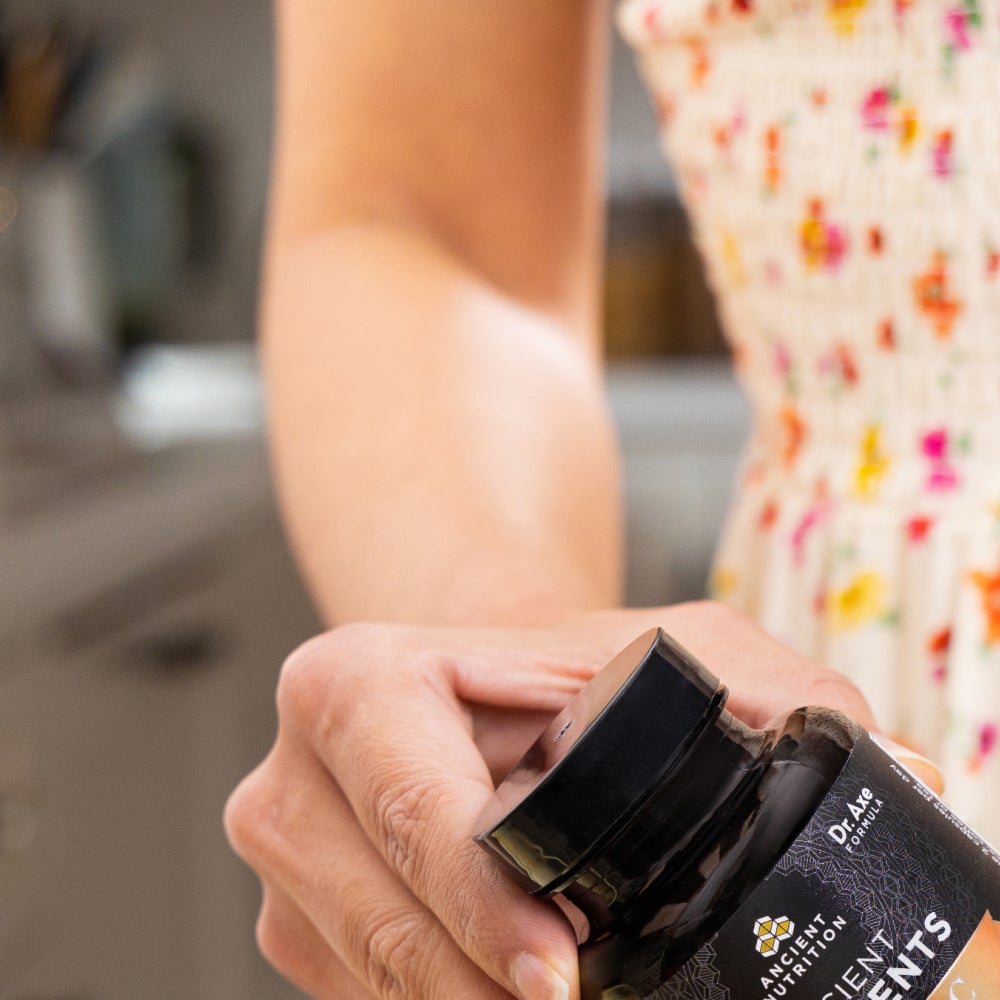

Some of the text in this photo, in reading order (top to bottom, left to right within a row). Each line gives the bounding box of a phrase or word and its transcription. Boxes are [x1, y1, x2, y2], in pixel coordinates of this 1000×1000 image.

[828, 787, 873, 845] Dr. Axe
[845, 799, 884, 853] FORMULA
[760, 913, 826, 989] ANCIENT
